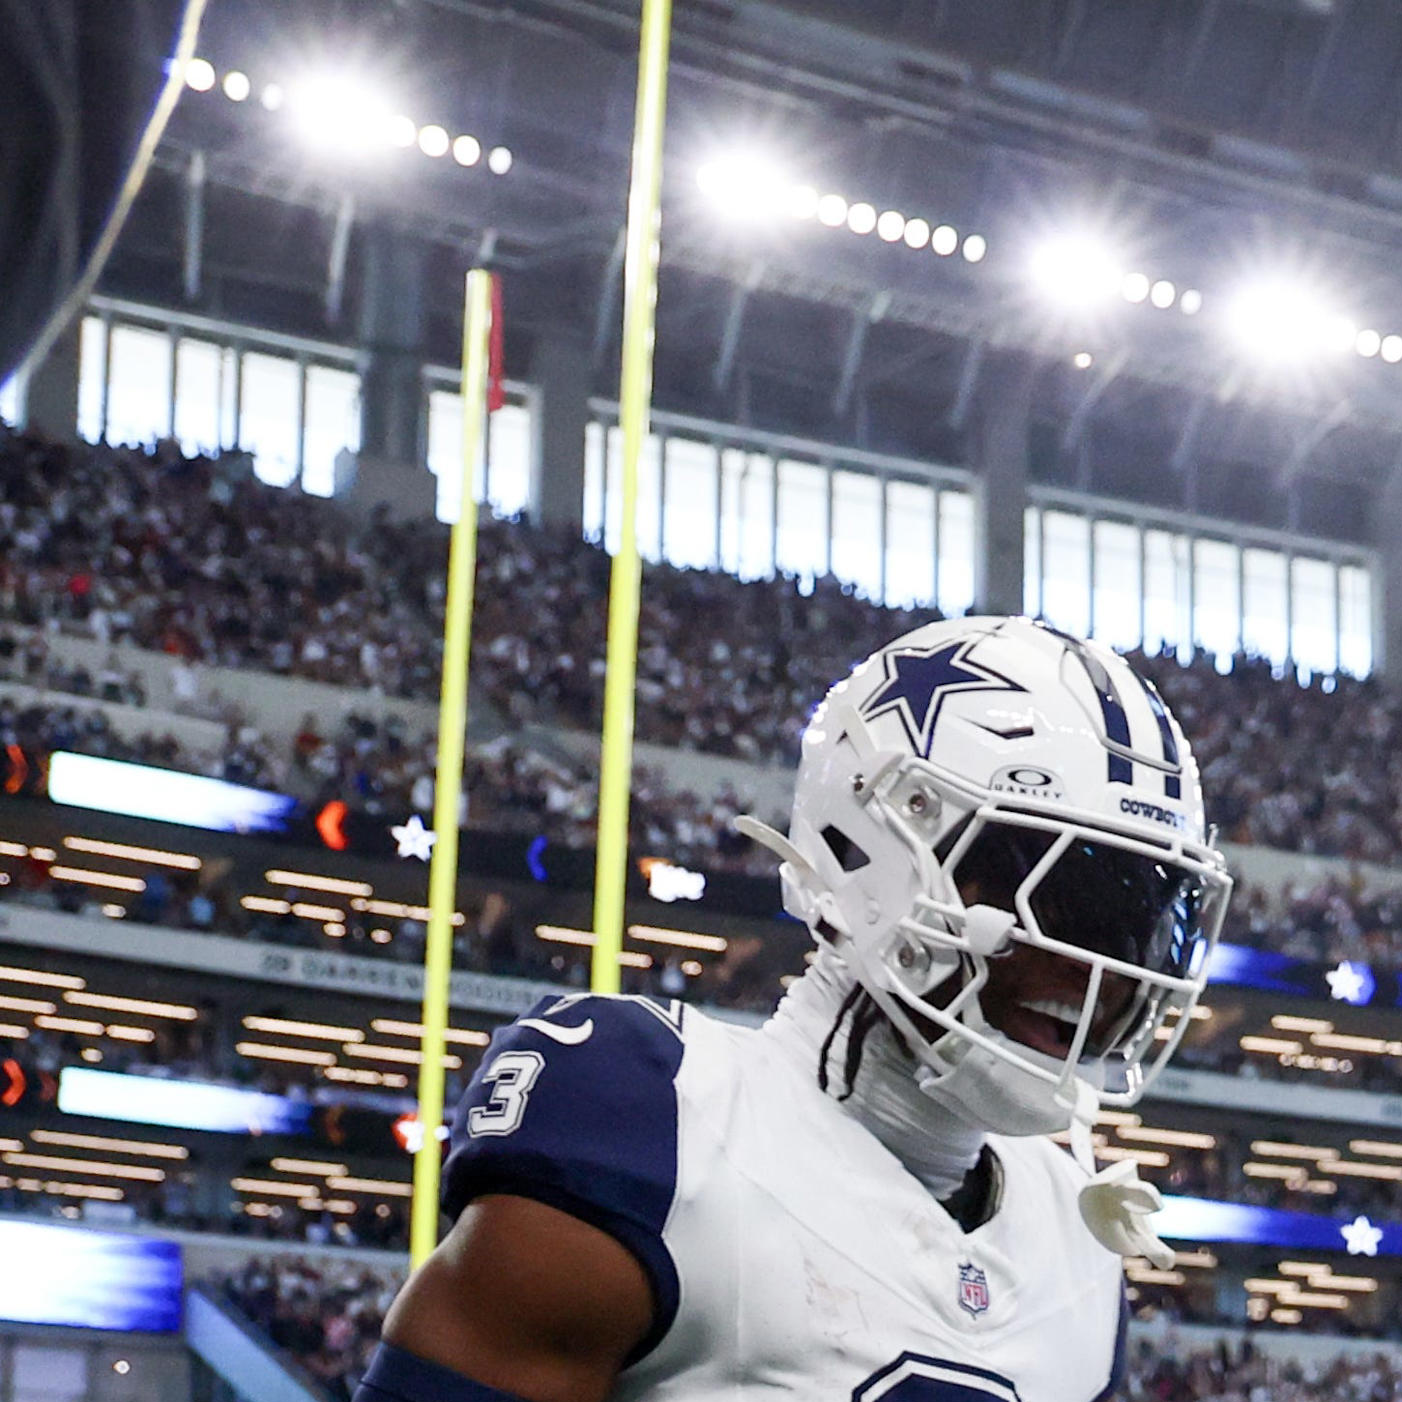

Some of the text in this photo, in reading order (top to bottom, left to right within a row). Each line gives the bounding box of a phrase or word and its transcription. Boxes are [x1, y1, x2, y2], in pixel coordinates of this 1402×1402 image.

[994, 783, 1063, 799] OAKLEY
[1119, 798, 1187, 831] COWBOY
[466, 1050, 546, 1139] 3
